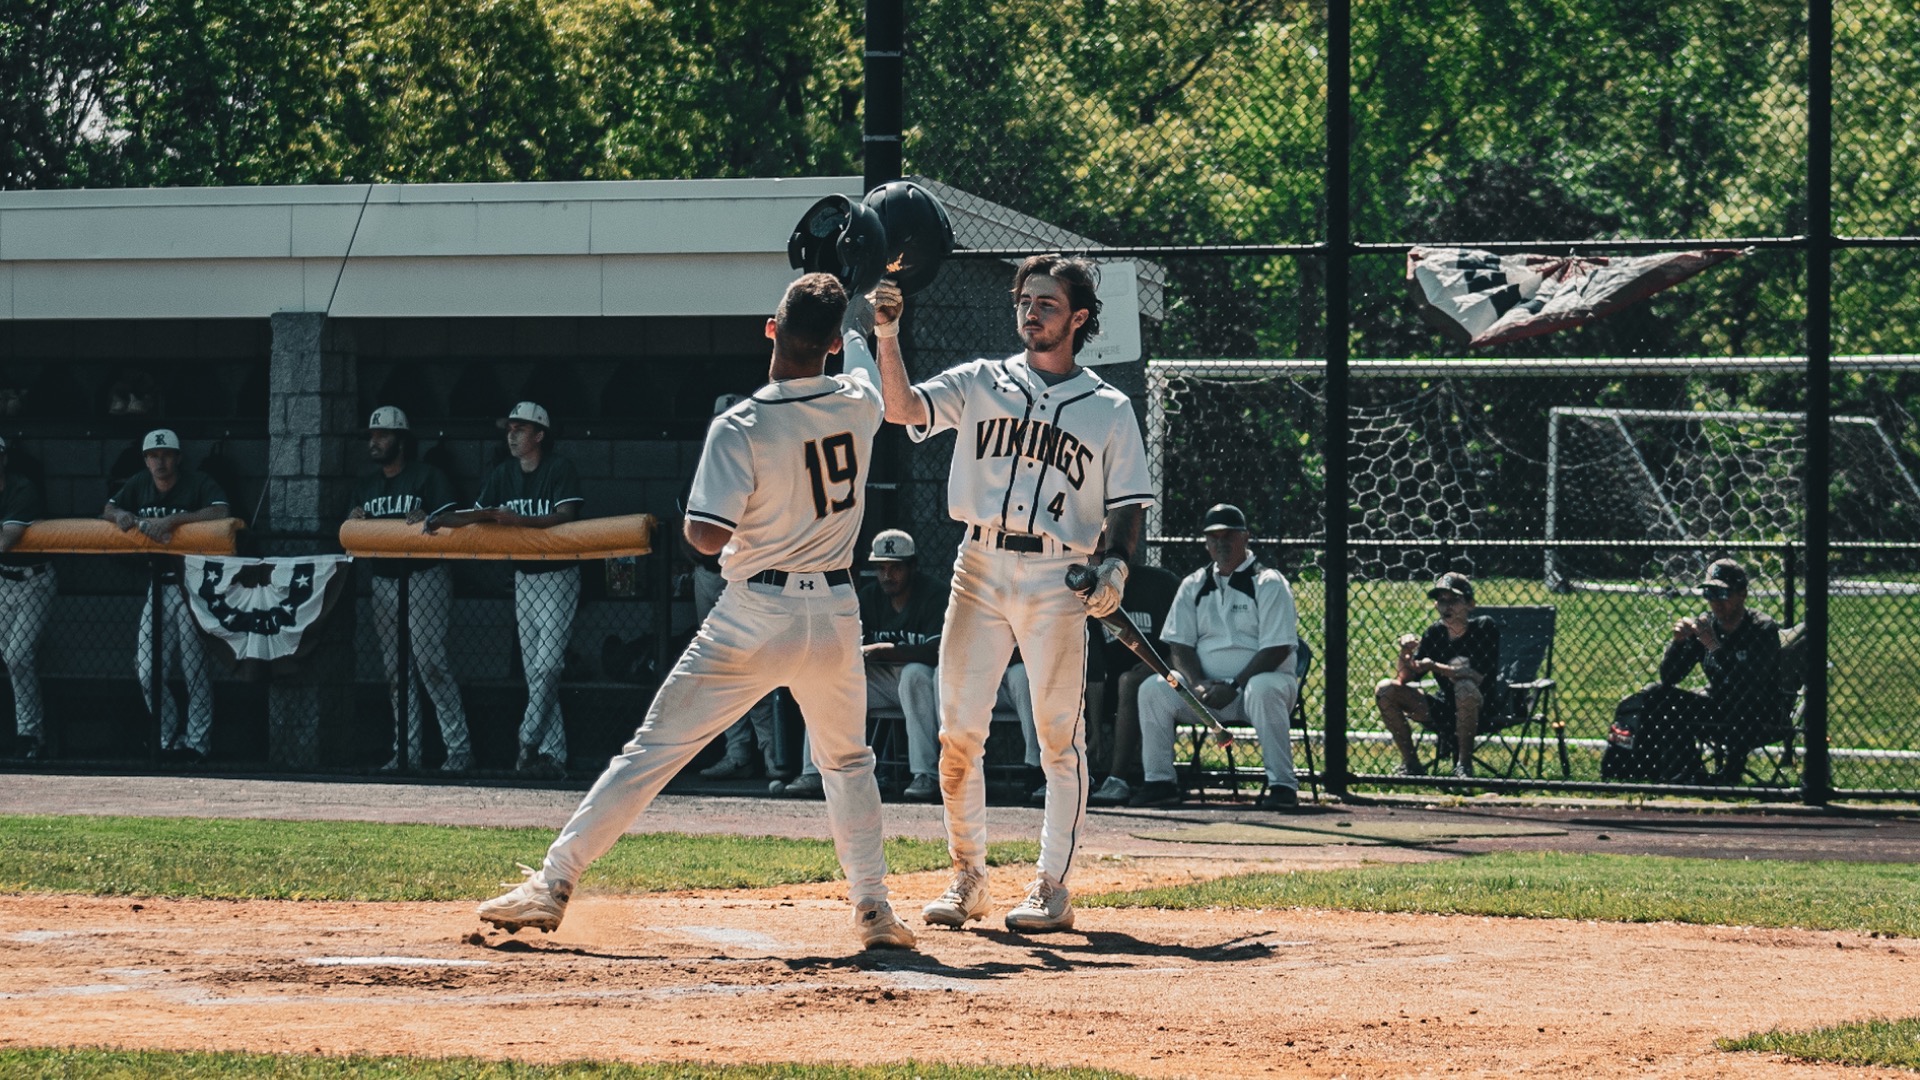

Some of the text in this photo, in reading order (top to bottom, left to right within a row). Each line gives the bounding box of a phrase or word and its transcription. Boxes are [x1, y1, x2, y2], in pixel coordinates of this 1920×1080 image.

[372, 412, 381, 425] R
[155, 433, 166, 446] R
[976, 417, 1094, 490] VIKINGS
[804, 432, 857, 519] 19
[364, 494, 422, 516] OCKLAND
[1047, 492, 1065, 522] 4
[884, 540, 895, 554] R
